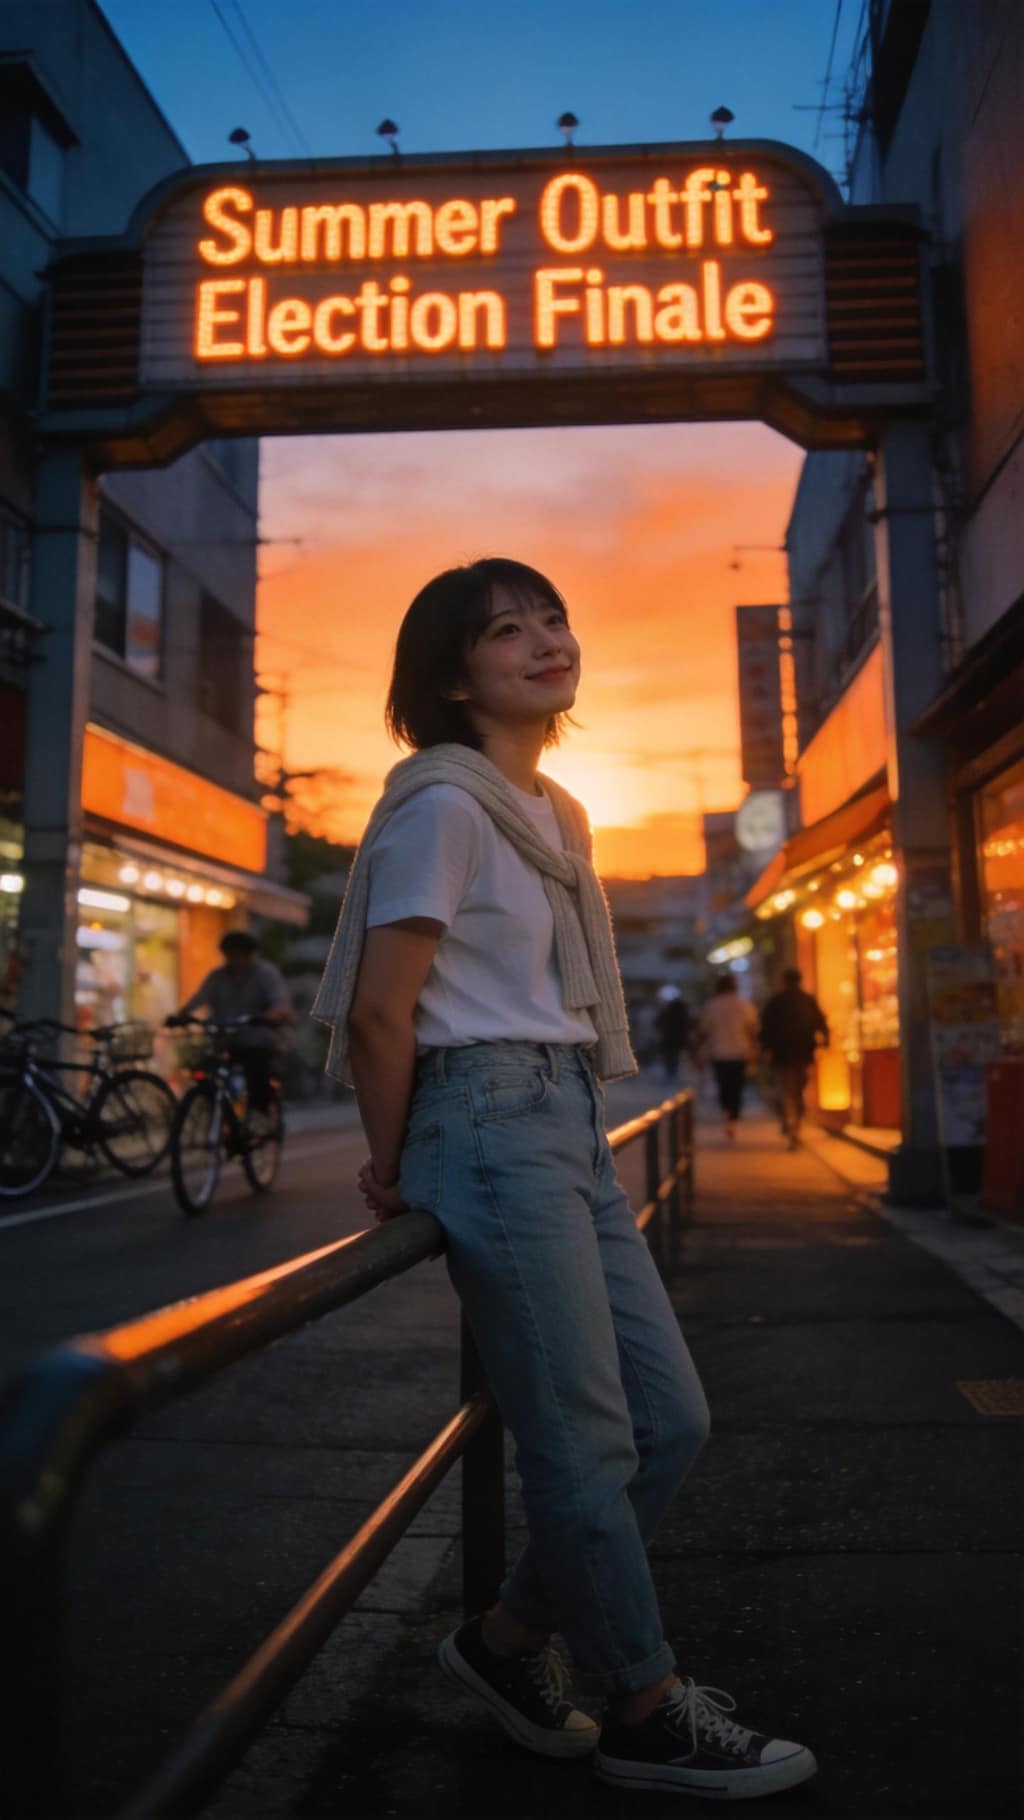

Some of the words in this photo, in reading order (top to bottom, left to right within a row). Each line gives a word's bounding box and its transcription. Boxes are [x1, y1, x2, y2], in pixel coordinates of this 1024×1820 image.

[198, 186, 515, 266] Summer
[539, 168, 773, 253] Outfit
[194, 275, 507, 360] Election
[534, 260, 774, 347] Finale
